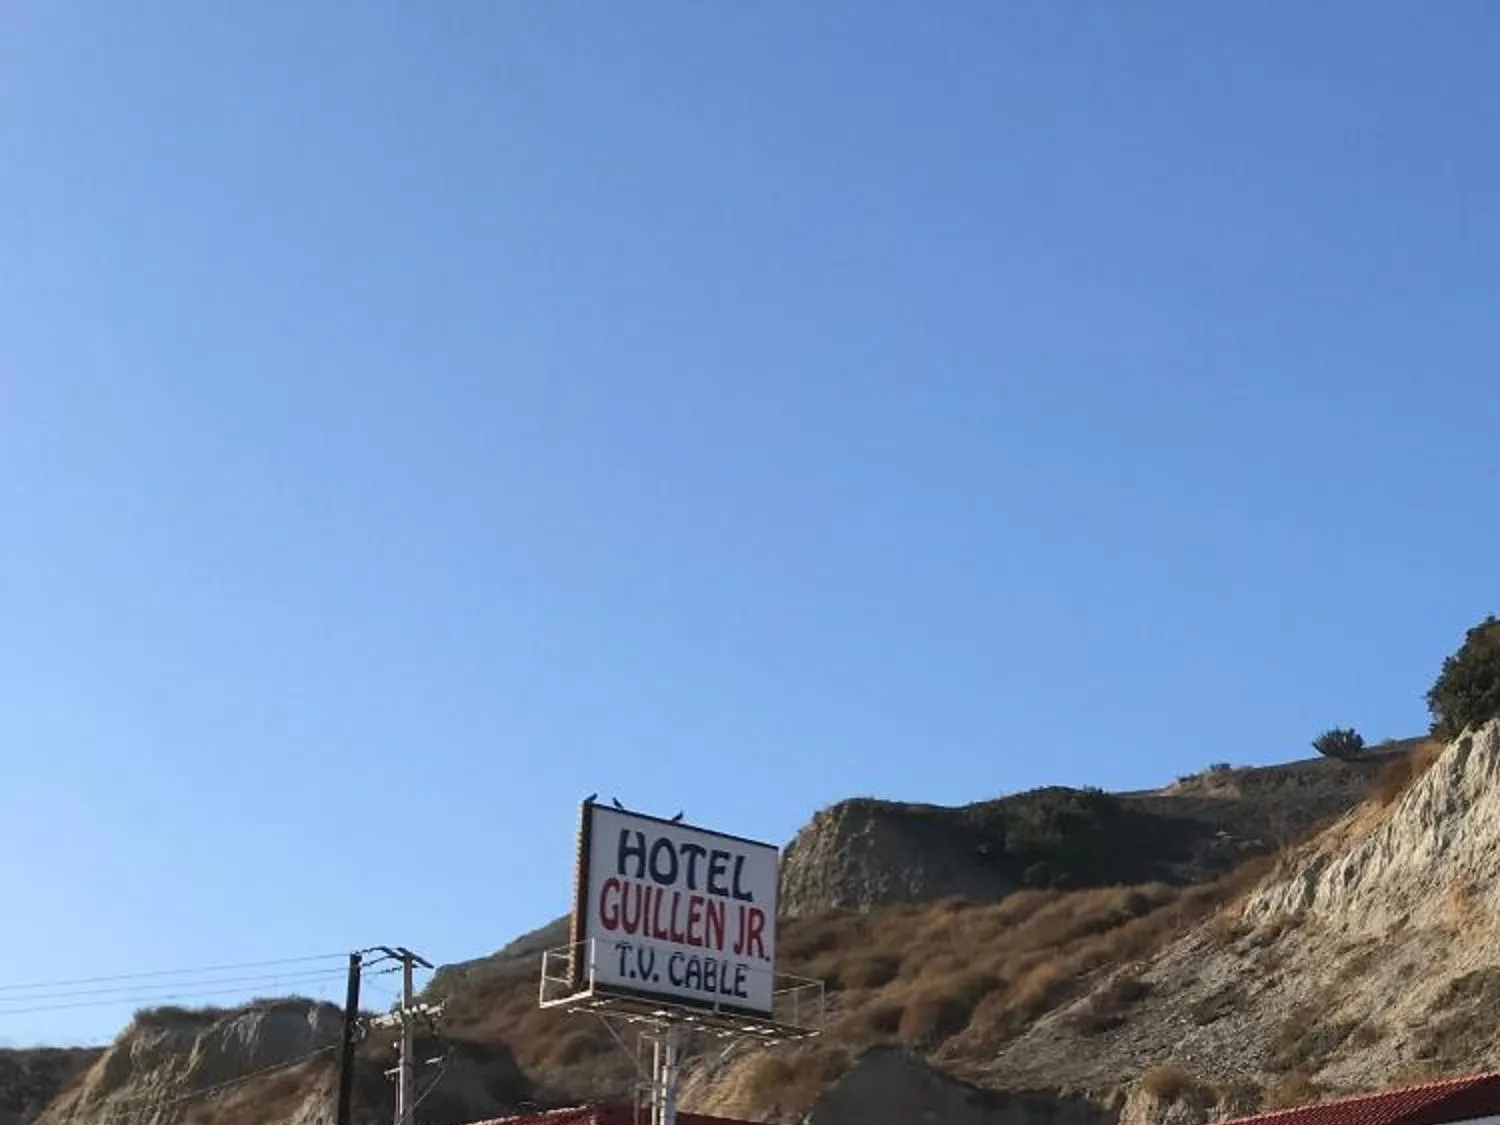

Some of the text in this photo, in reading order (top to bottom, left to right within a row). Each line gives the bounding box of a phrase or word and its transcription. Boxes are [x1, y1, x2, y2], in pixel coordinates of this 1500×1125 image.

[617, 828, 754, 903] HOTEL
[599, 876, 726, 952] GUILLEN
[615, 940, 750, 1000] T.V. CABLE
